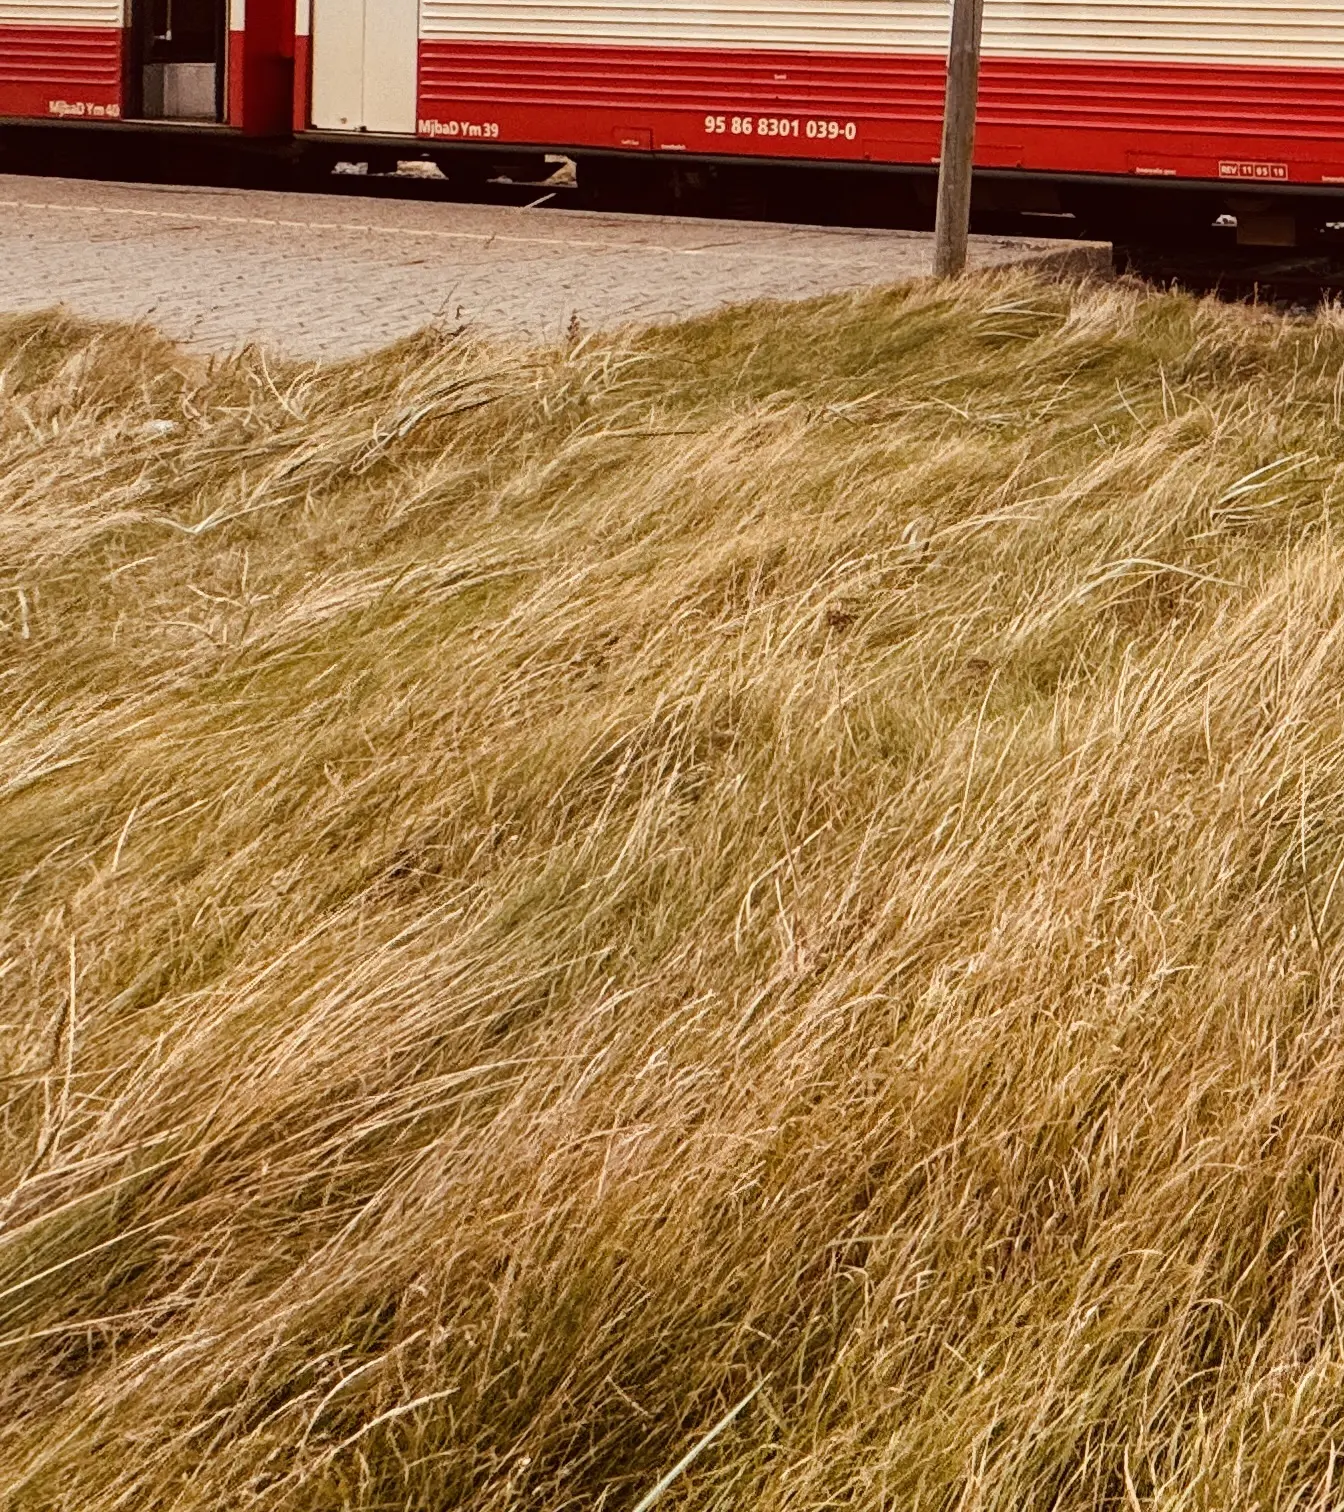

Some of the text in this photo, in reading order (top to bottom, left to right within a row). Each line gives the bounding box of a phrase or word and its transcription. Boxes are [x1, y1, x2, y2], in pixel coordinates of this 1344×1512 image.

[86, 102, 105, 116] Ym
[418, 119, 499, 138] MjbaD Ym 39
[704, 116, 858, 141] 95 86 8301 039-0
[1242, 165, 1252, 175] 11
